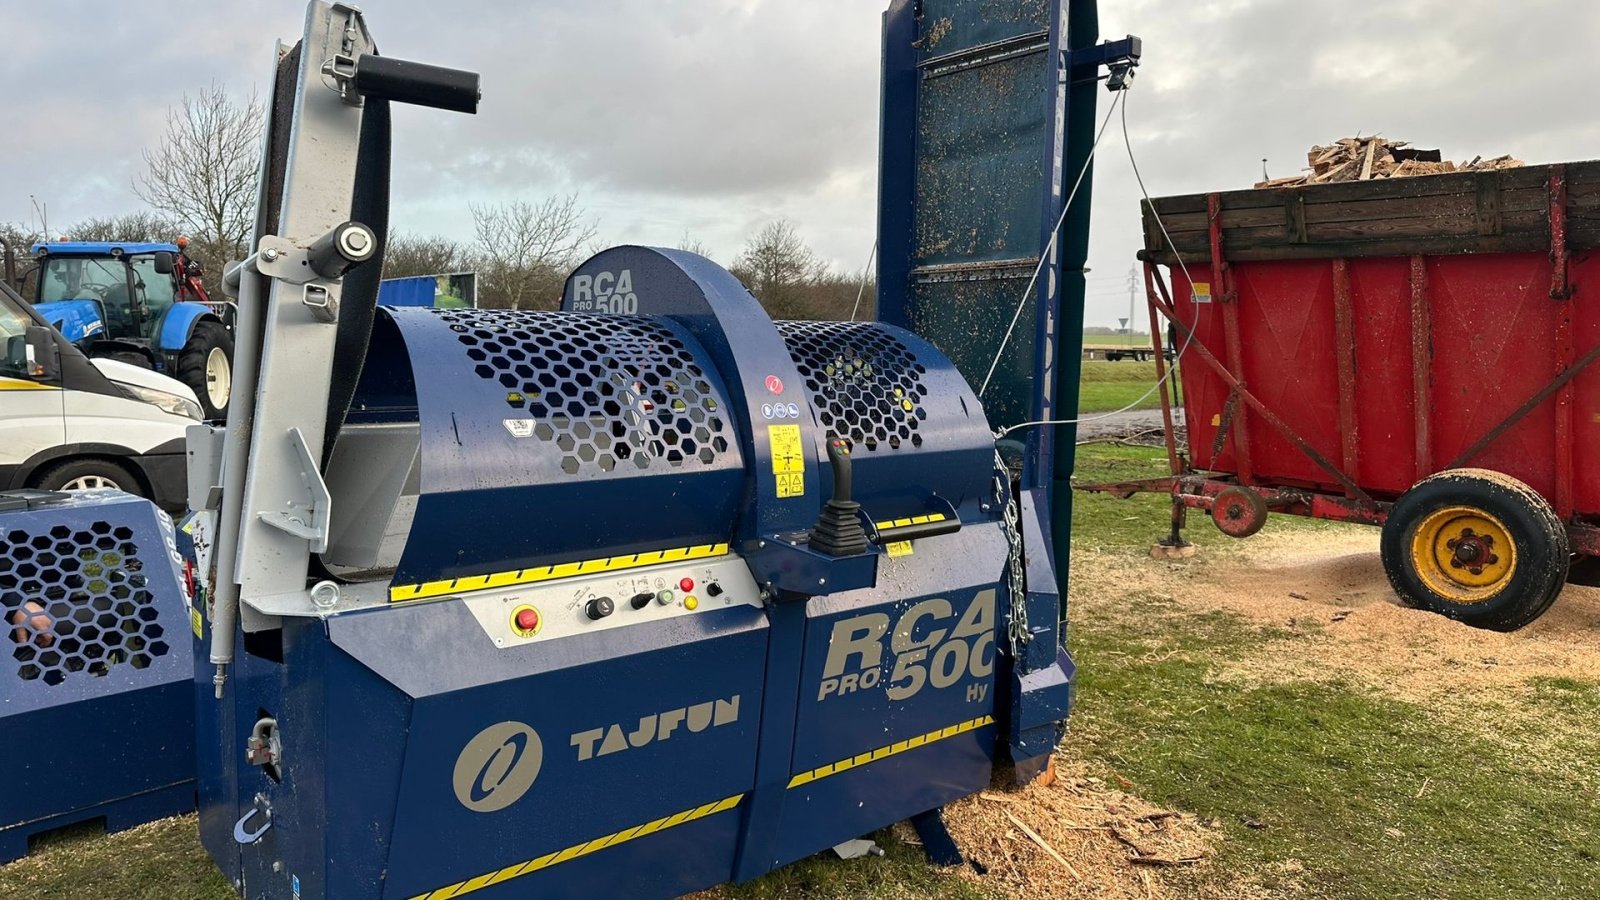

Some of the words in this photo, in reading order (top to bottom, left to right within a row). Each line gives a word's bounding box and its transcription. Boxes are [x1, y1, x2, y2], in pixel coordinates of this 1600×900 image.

[573, 301, 592, 311] PRO
[595, 292, 637, 315] 500
[574, 270, 632, 301] RCA
[822, 588, 996, 680] RCA
[817, 667, 881, 702] PRO
[886, 631, 995, 702] 500
[965, 682, 989, 704] Hy
[570, 694, 741, 762] TAJFUN
